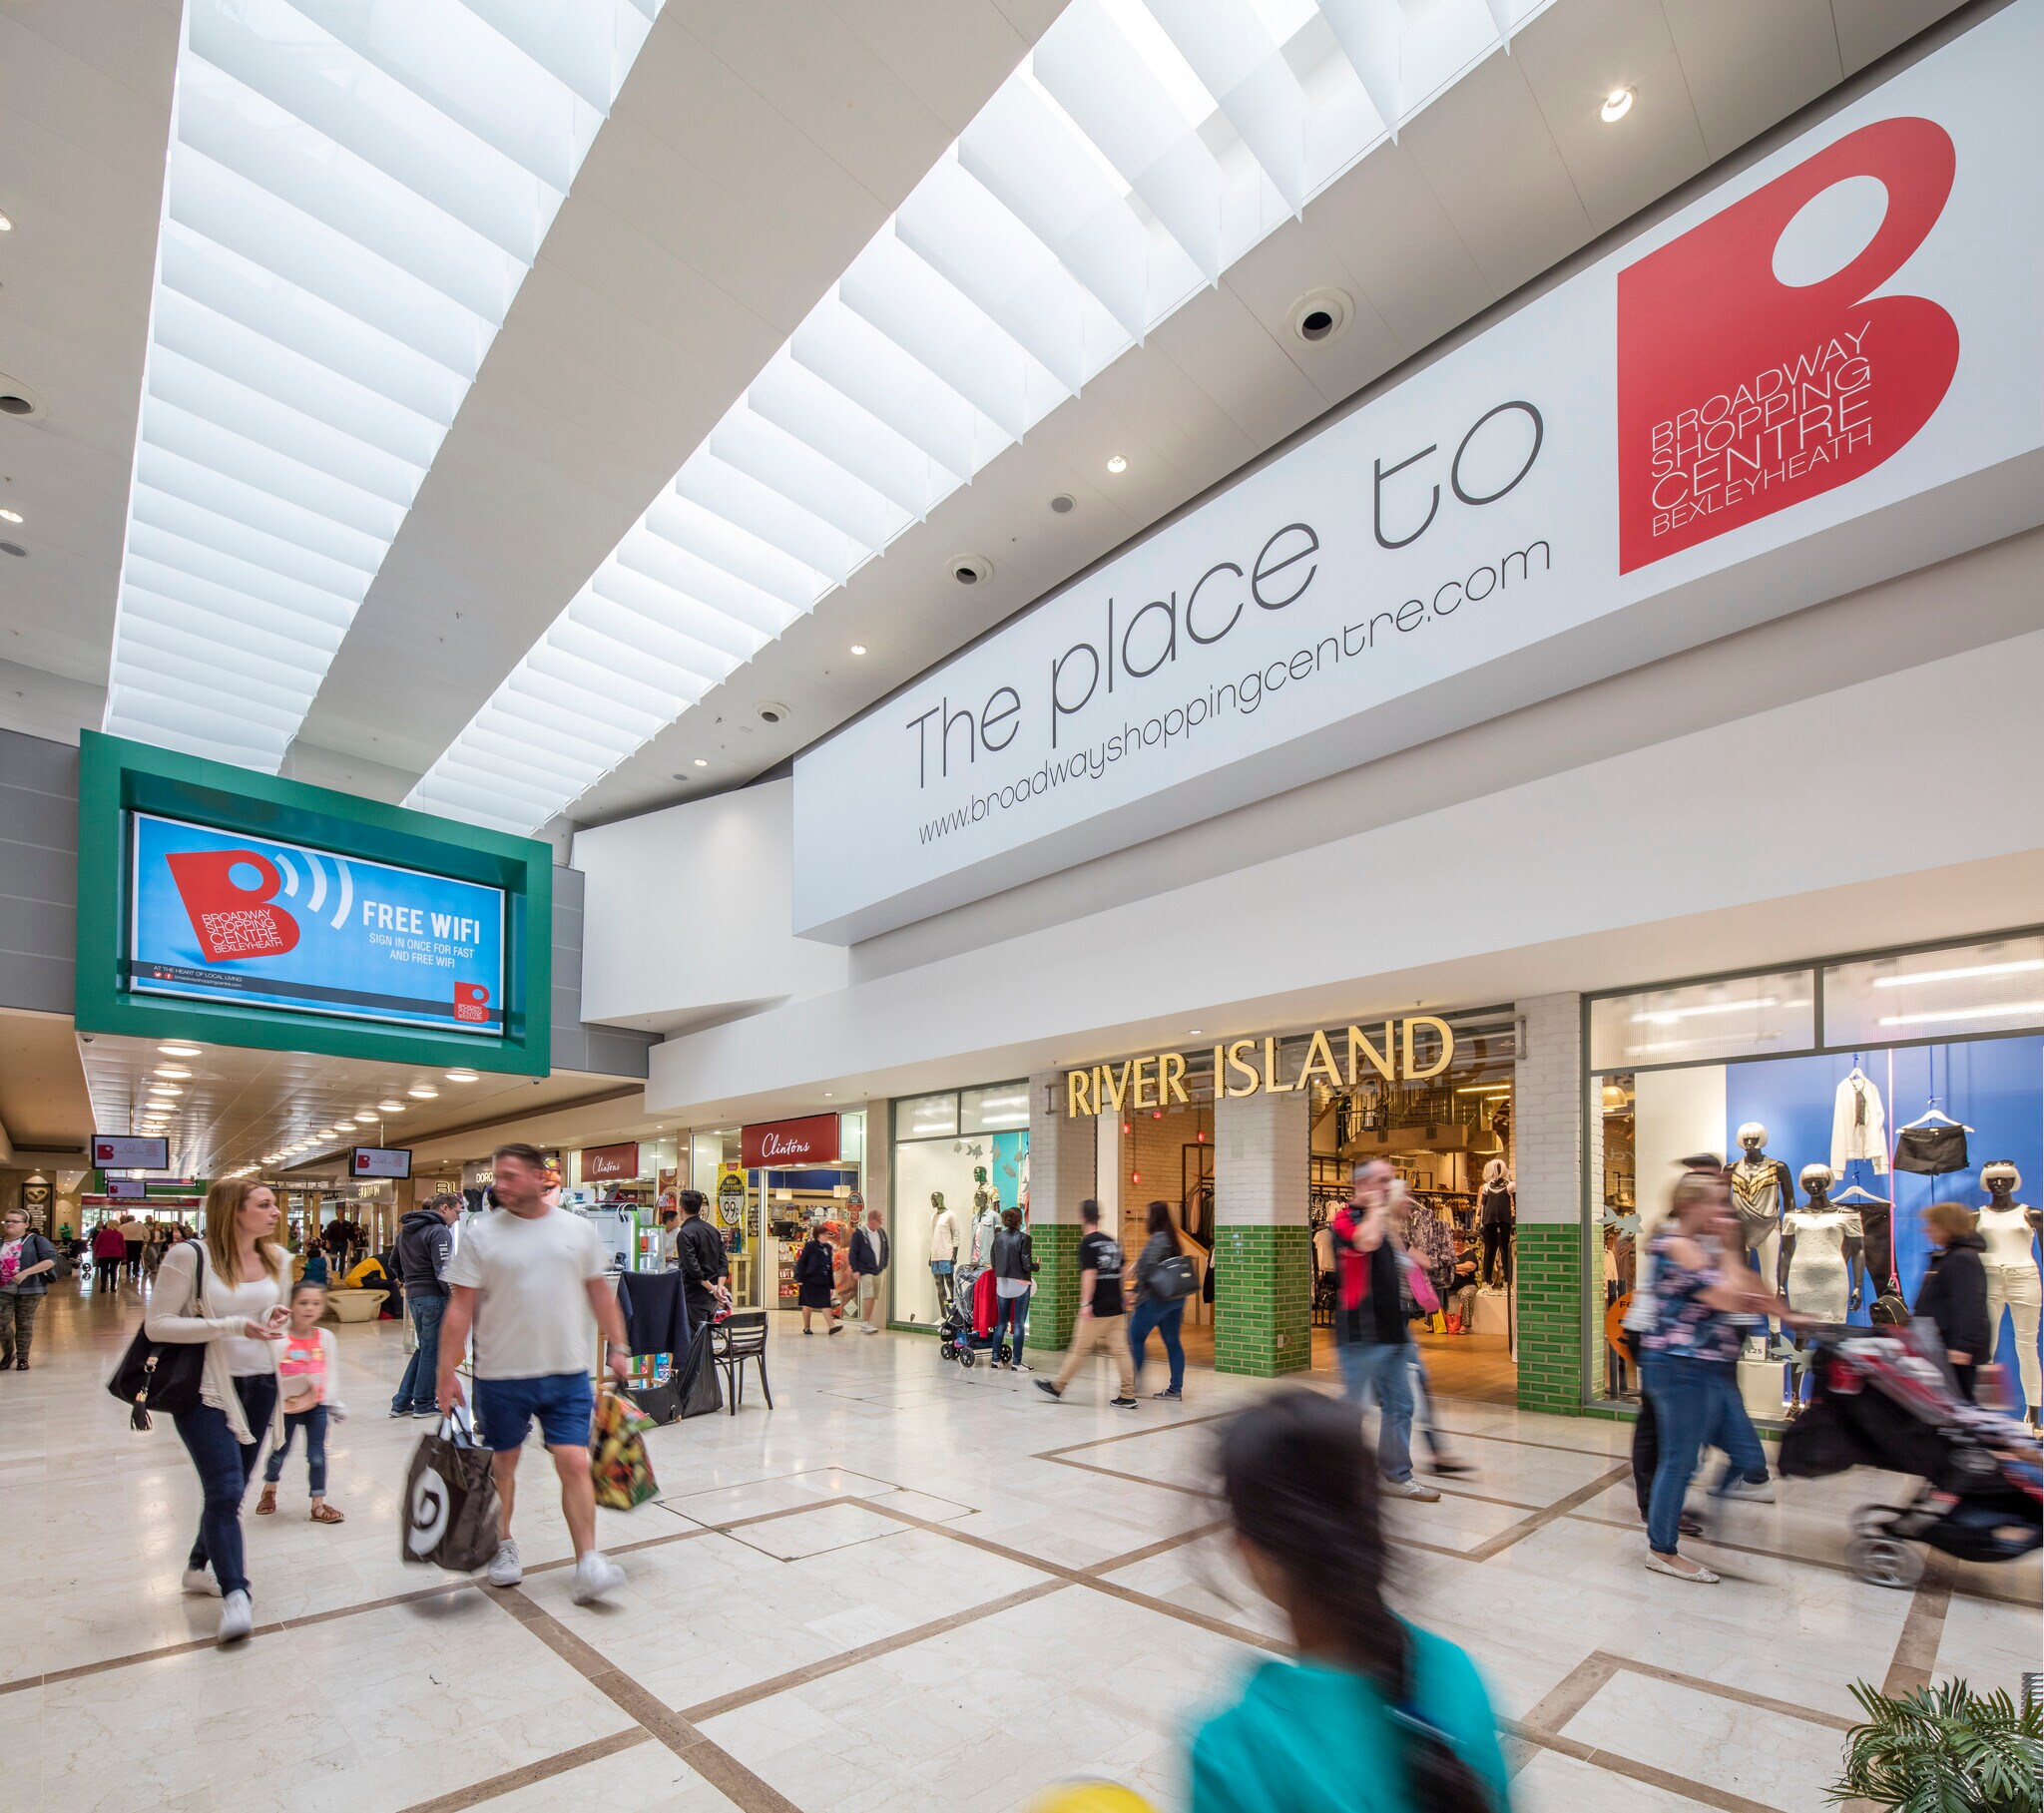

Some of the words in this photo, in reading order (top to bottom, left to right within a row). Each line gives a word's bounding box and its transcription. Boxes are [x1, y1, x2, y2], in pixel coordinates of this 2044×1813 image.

[1652, 319, 1871, 452] BROADWAY
[1651, 356, 1870, 478] SHOPPING
[1652, 383, 1872, 510] CENTRE
[1652, 423, 1871, 537] BEXLEYHEATH
[905, 685, 1021, 789] The
[1052, 522, 1320, 749] place
[1372, 400, 1545, 550] to
[917, 540, 1551, 846] www.broadwayshoppingcentre.com
[202, 909, 270, 924] BROADWAY
[205, 918, 276, 934] SHOPPING
[362, 900, 424, 935] FREE
[430, 912, 480, 945] WIFI
[210, 927, 281, 945] CENTRE
[214, 940, 283, 953] BEXLEYHEATH
[369, 932, 392, 946] SIGN
[395, 937, 405, 948] IN
[407, 939, 431, 952] ONCE
[433, 943, 451, 955] FOR
[453, 946, 475, 958] FAST
[389, 949, 410, 962] AND
[411, 952, 434, 965] FREE
[436, 956, 455, 969] WIFI
[1068, 1052, 1191, 1119] RIVER
[1214, 1015, 1456, 1099] ISLAND
[761, 1133, 810, 1158] Clintons
[592, 1155, 621, 1175] Clintons
[724, 1200, 740, 1218] 99p
